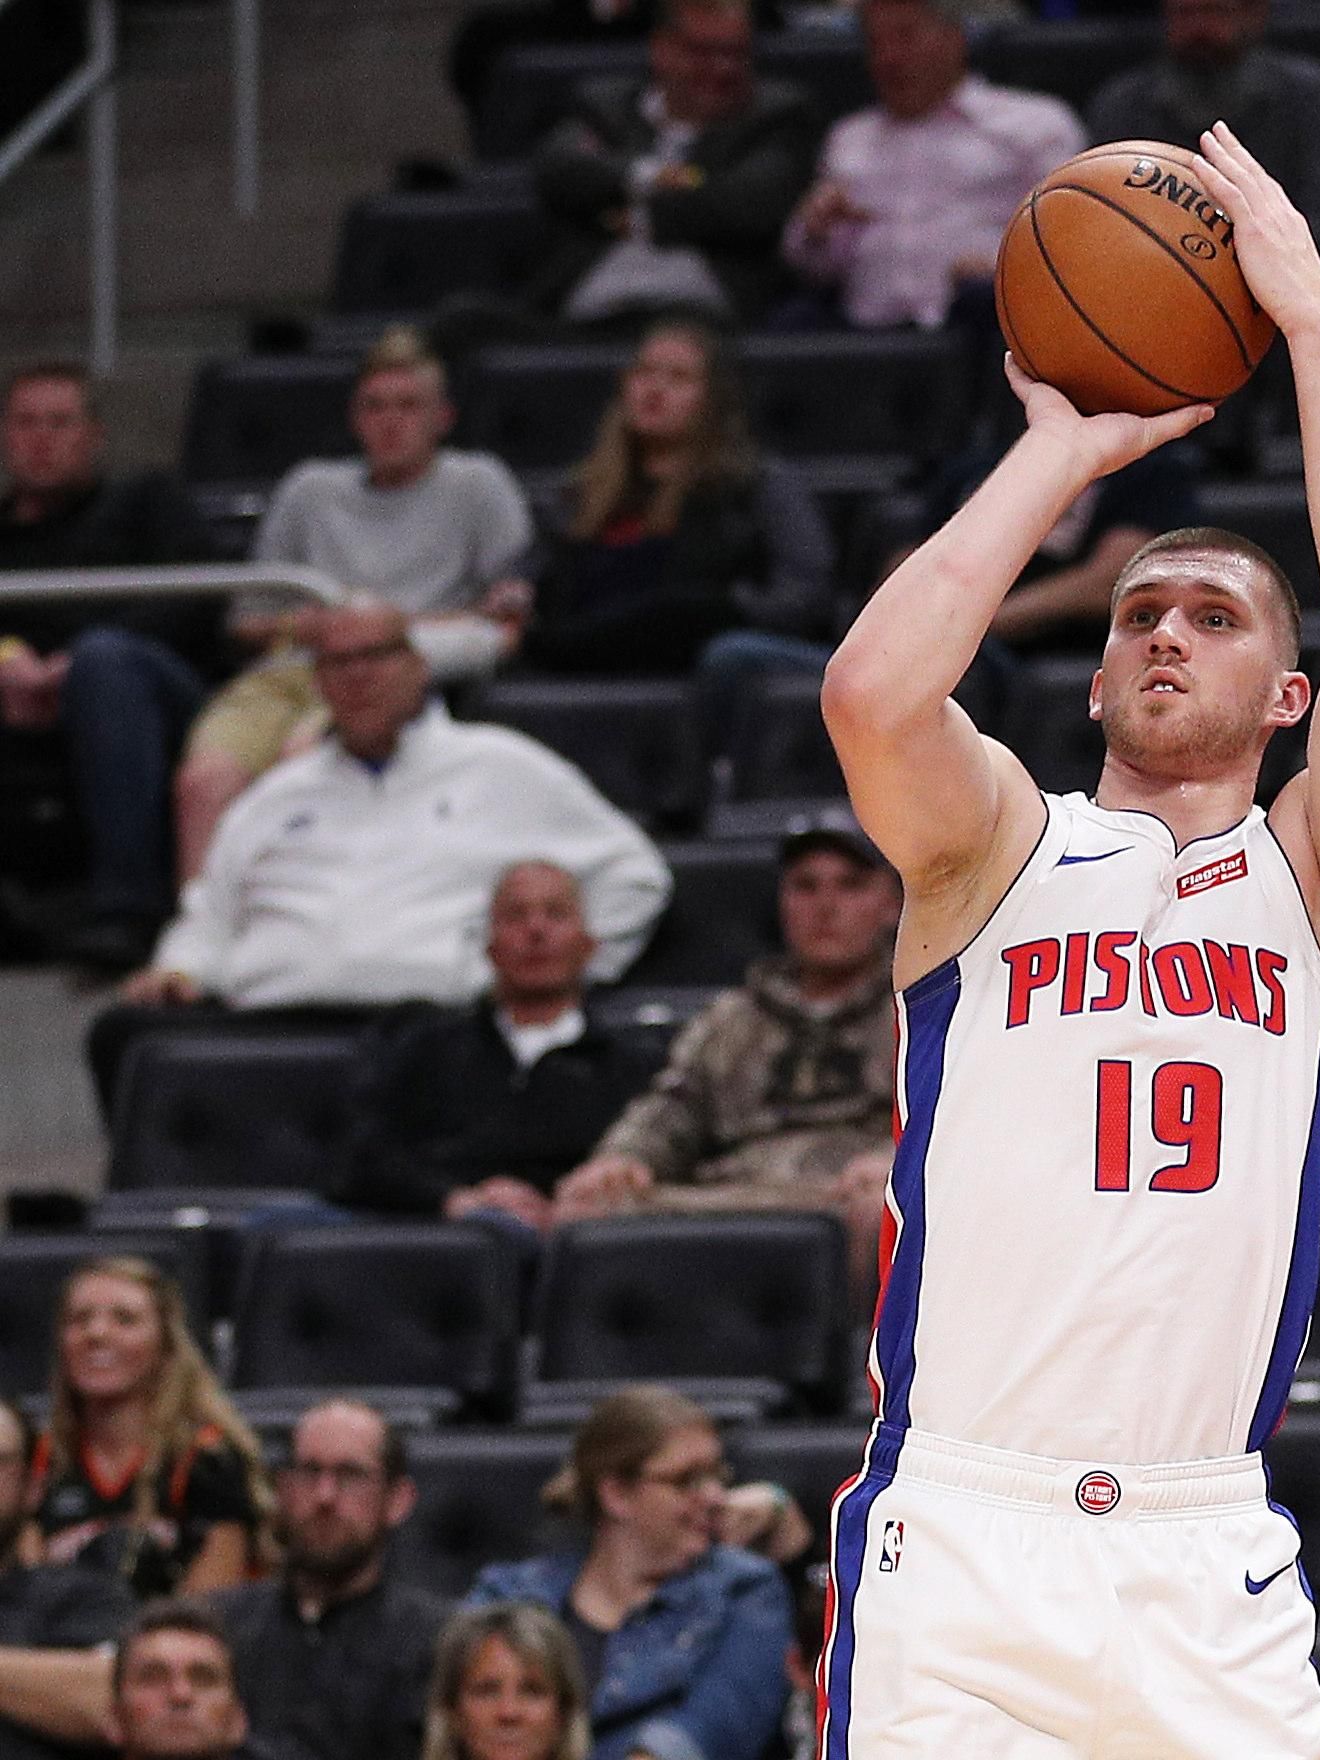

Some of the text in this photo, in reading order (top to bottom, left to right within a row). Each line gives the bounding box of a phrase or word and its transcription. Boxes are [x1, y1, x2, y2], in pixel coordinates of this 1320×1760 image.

[1123, 159, 1235, 249] LDING
[1180, 856, 1243, 889] Flagstar
[1094, 1059, 1223, 1193] 19
